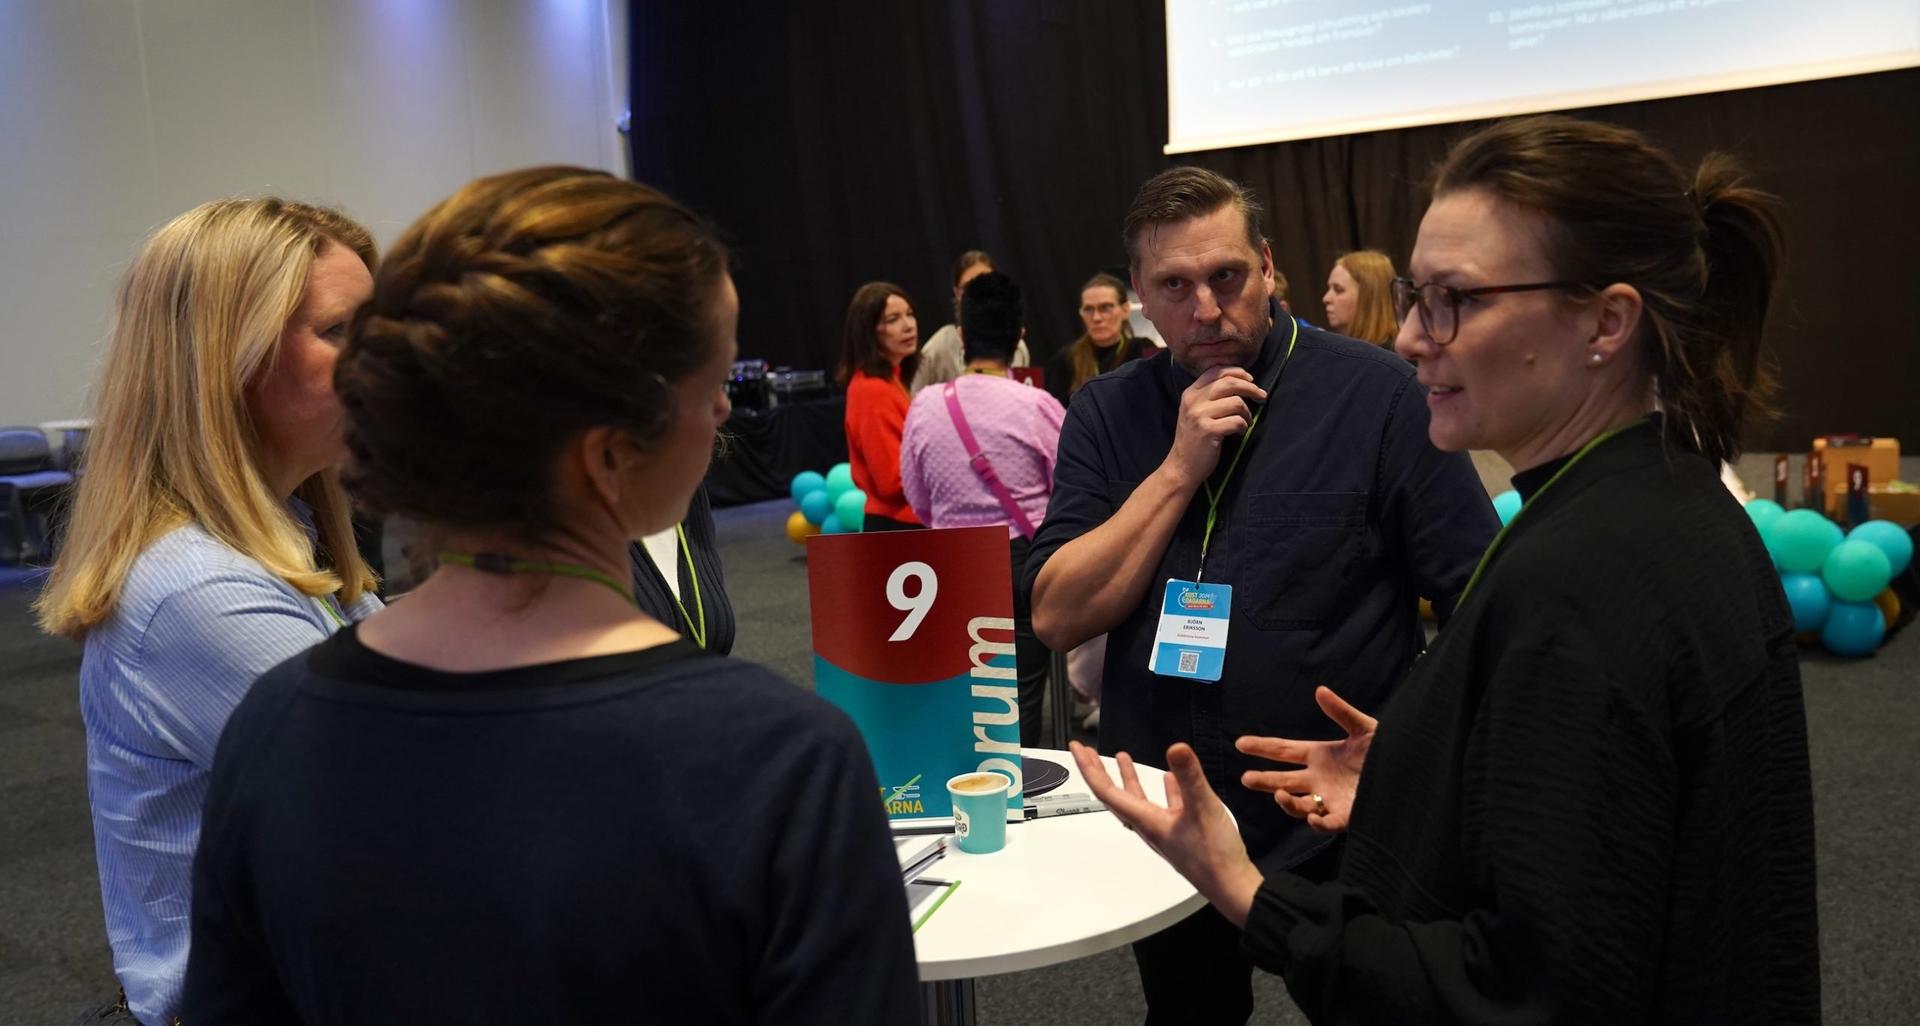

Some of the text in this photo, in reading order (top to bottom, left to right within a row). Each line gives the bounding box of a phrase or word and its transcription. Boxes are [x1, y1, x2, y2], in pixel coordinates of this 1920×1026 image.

[886, 561, 938, 642] 9
[967, 616, 1025, 821] orum
[885, 800, 924, 815] ARNA
